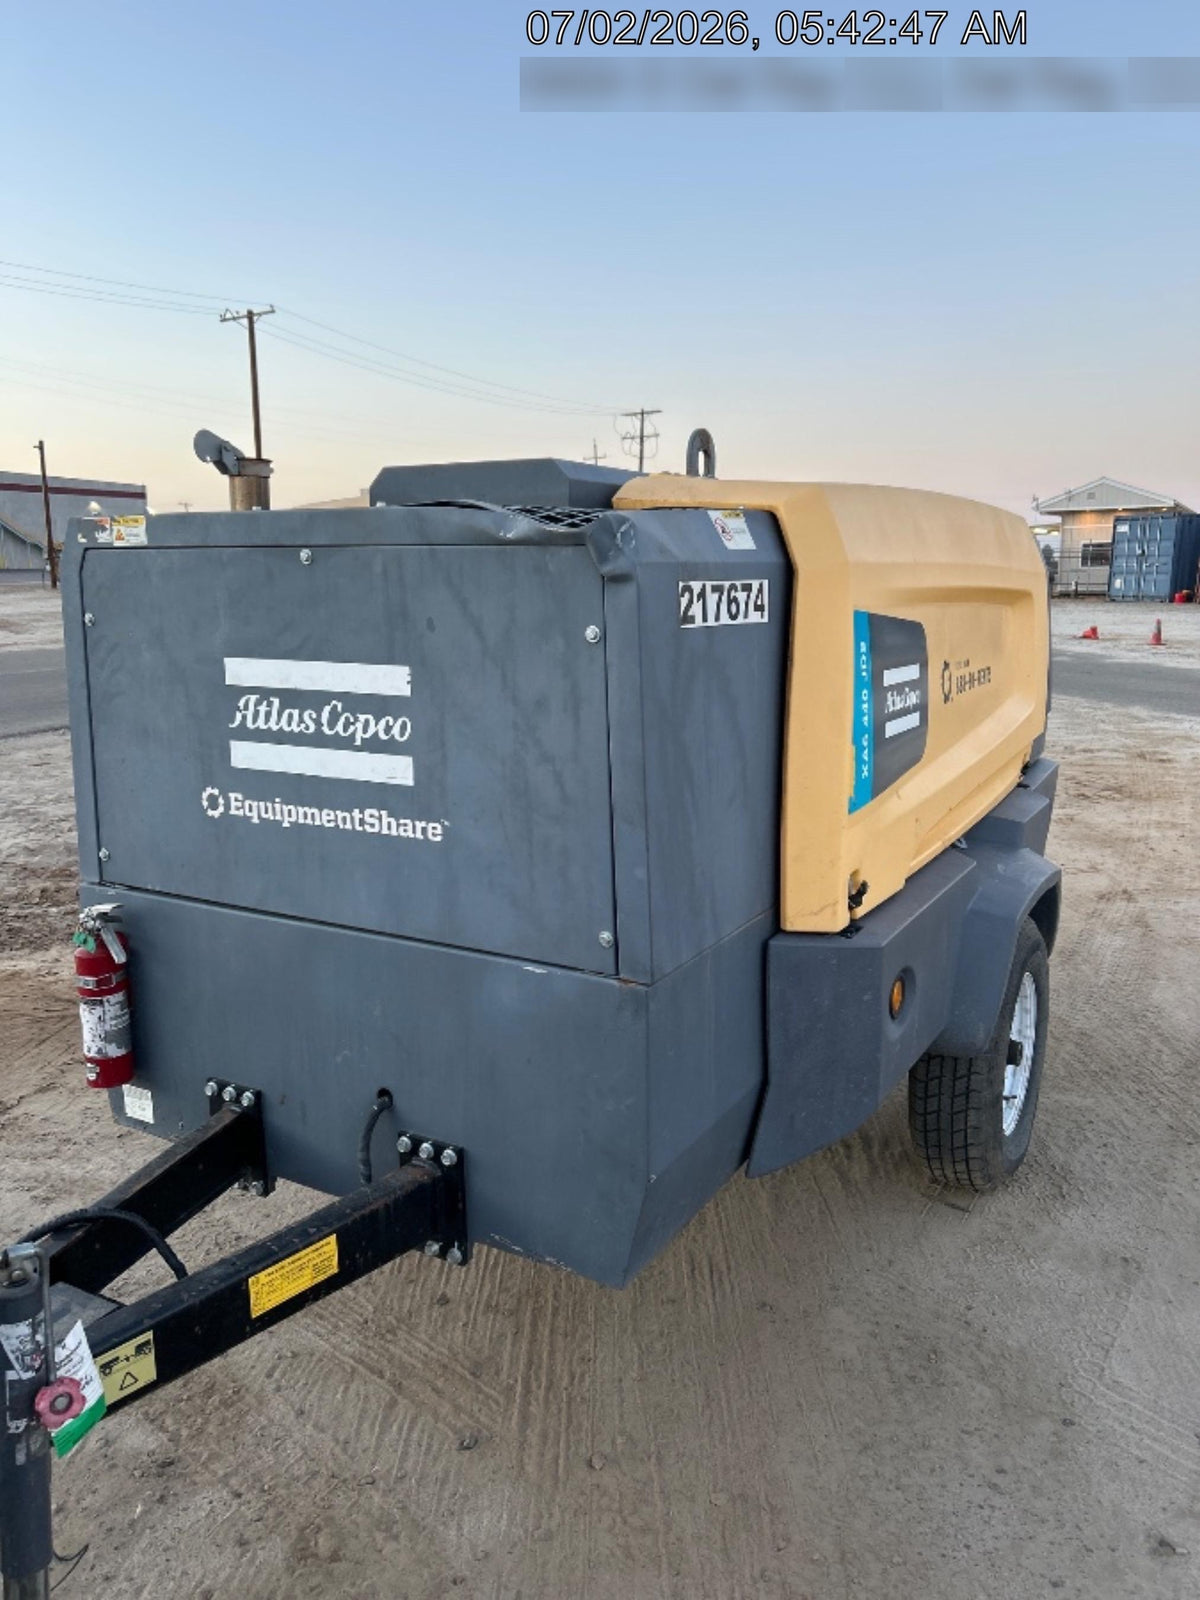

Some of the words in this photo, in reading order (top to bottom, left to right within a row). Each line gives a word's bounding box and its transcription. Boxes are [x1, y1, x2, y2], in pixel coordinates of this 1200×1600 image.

[680, 582, 765, 625] 217674
[229, 694, 317, 733] Atlas
[321, 700, 412, 745] Copco
[228, 792, 443, 842] EquipmentShare
